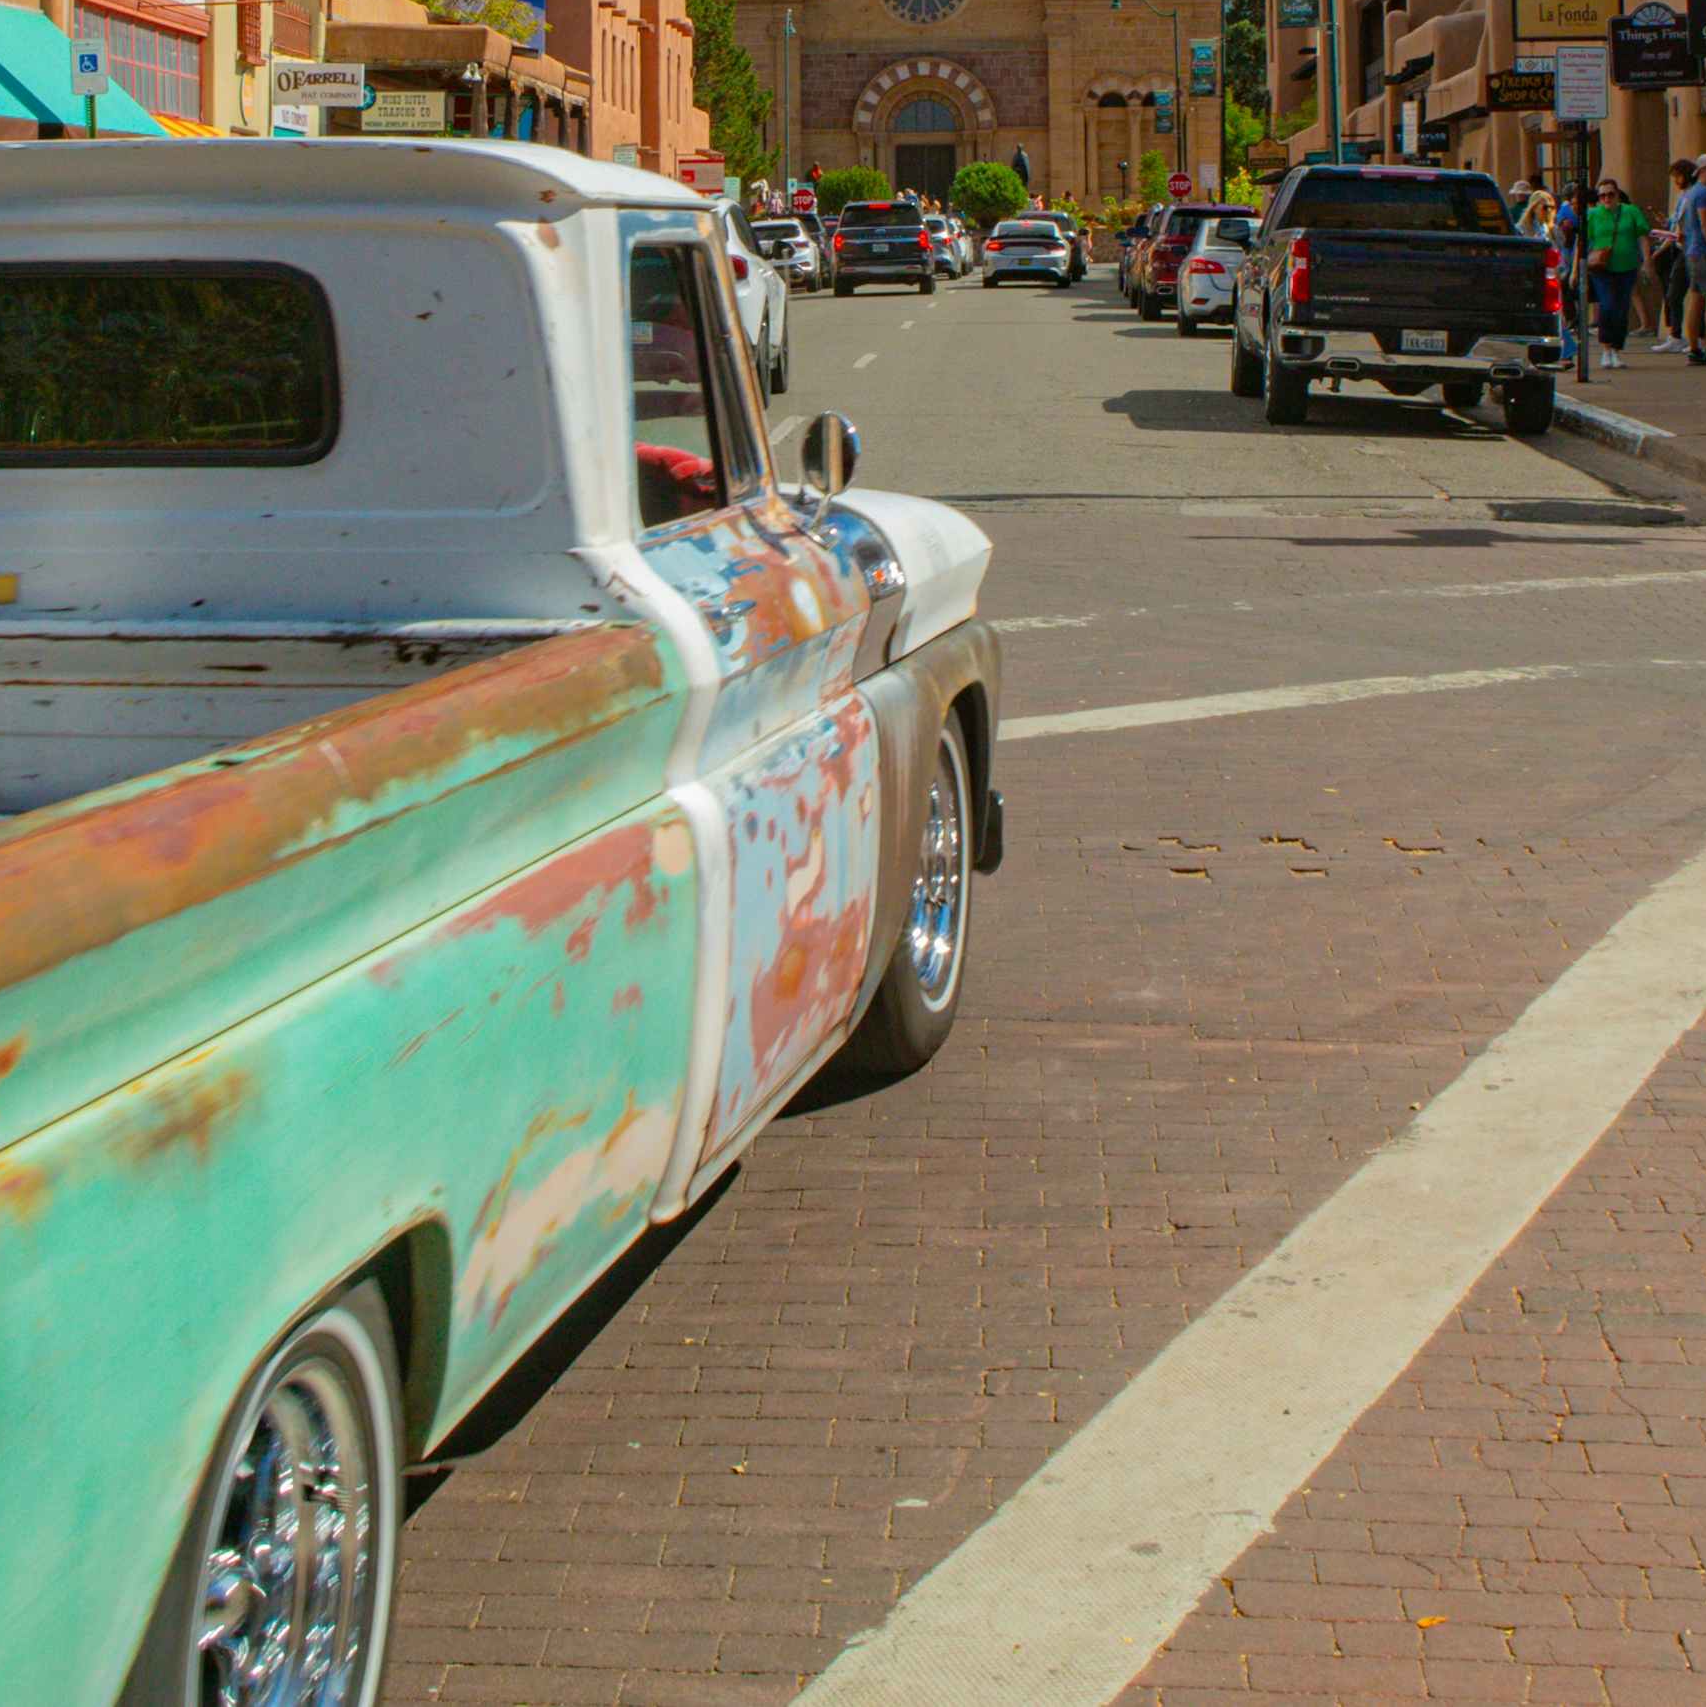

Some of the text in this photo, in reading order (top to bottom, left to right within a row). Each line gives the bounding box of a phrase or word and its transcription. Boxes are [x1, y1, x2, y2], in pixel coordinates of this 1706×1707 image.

[1539, 2, 1598, 27] La Fonda
[1617, 29, 1658, 44] Things
[276, 69, 359, 93] O'FARRELL
[319, 91, 357, 101] COMPANY
[377, 106, 417, 118] TRADING
[1169, 180, 1192, 191] STOP
[793, 195, 815, 206] STOP
